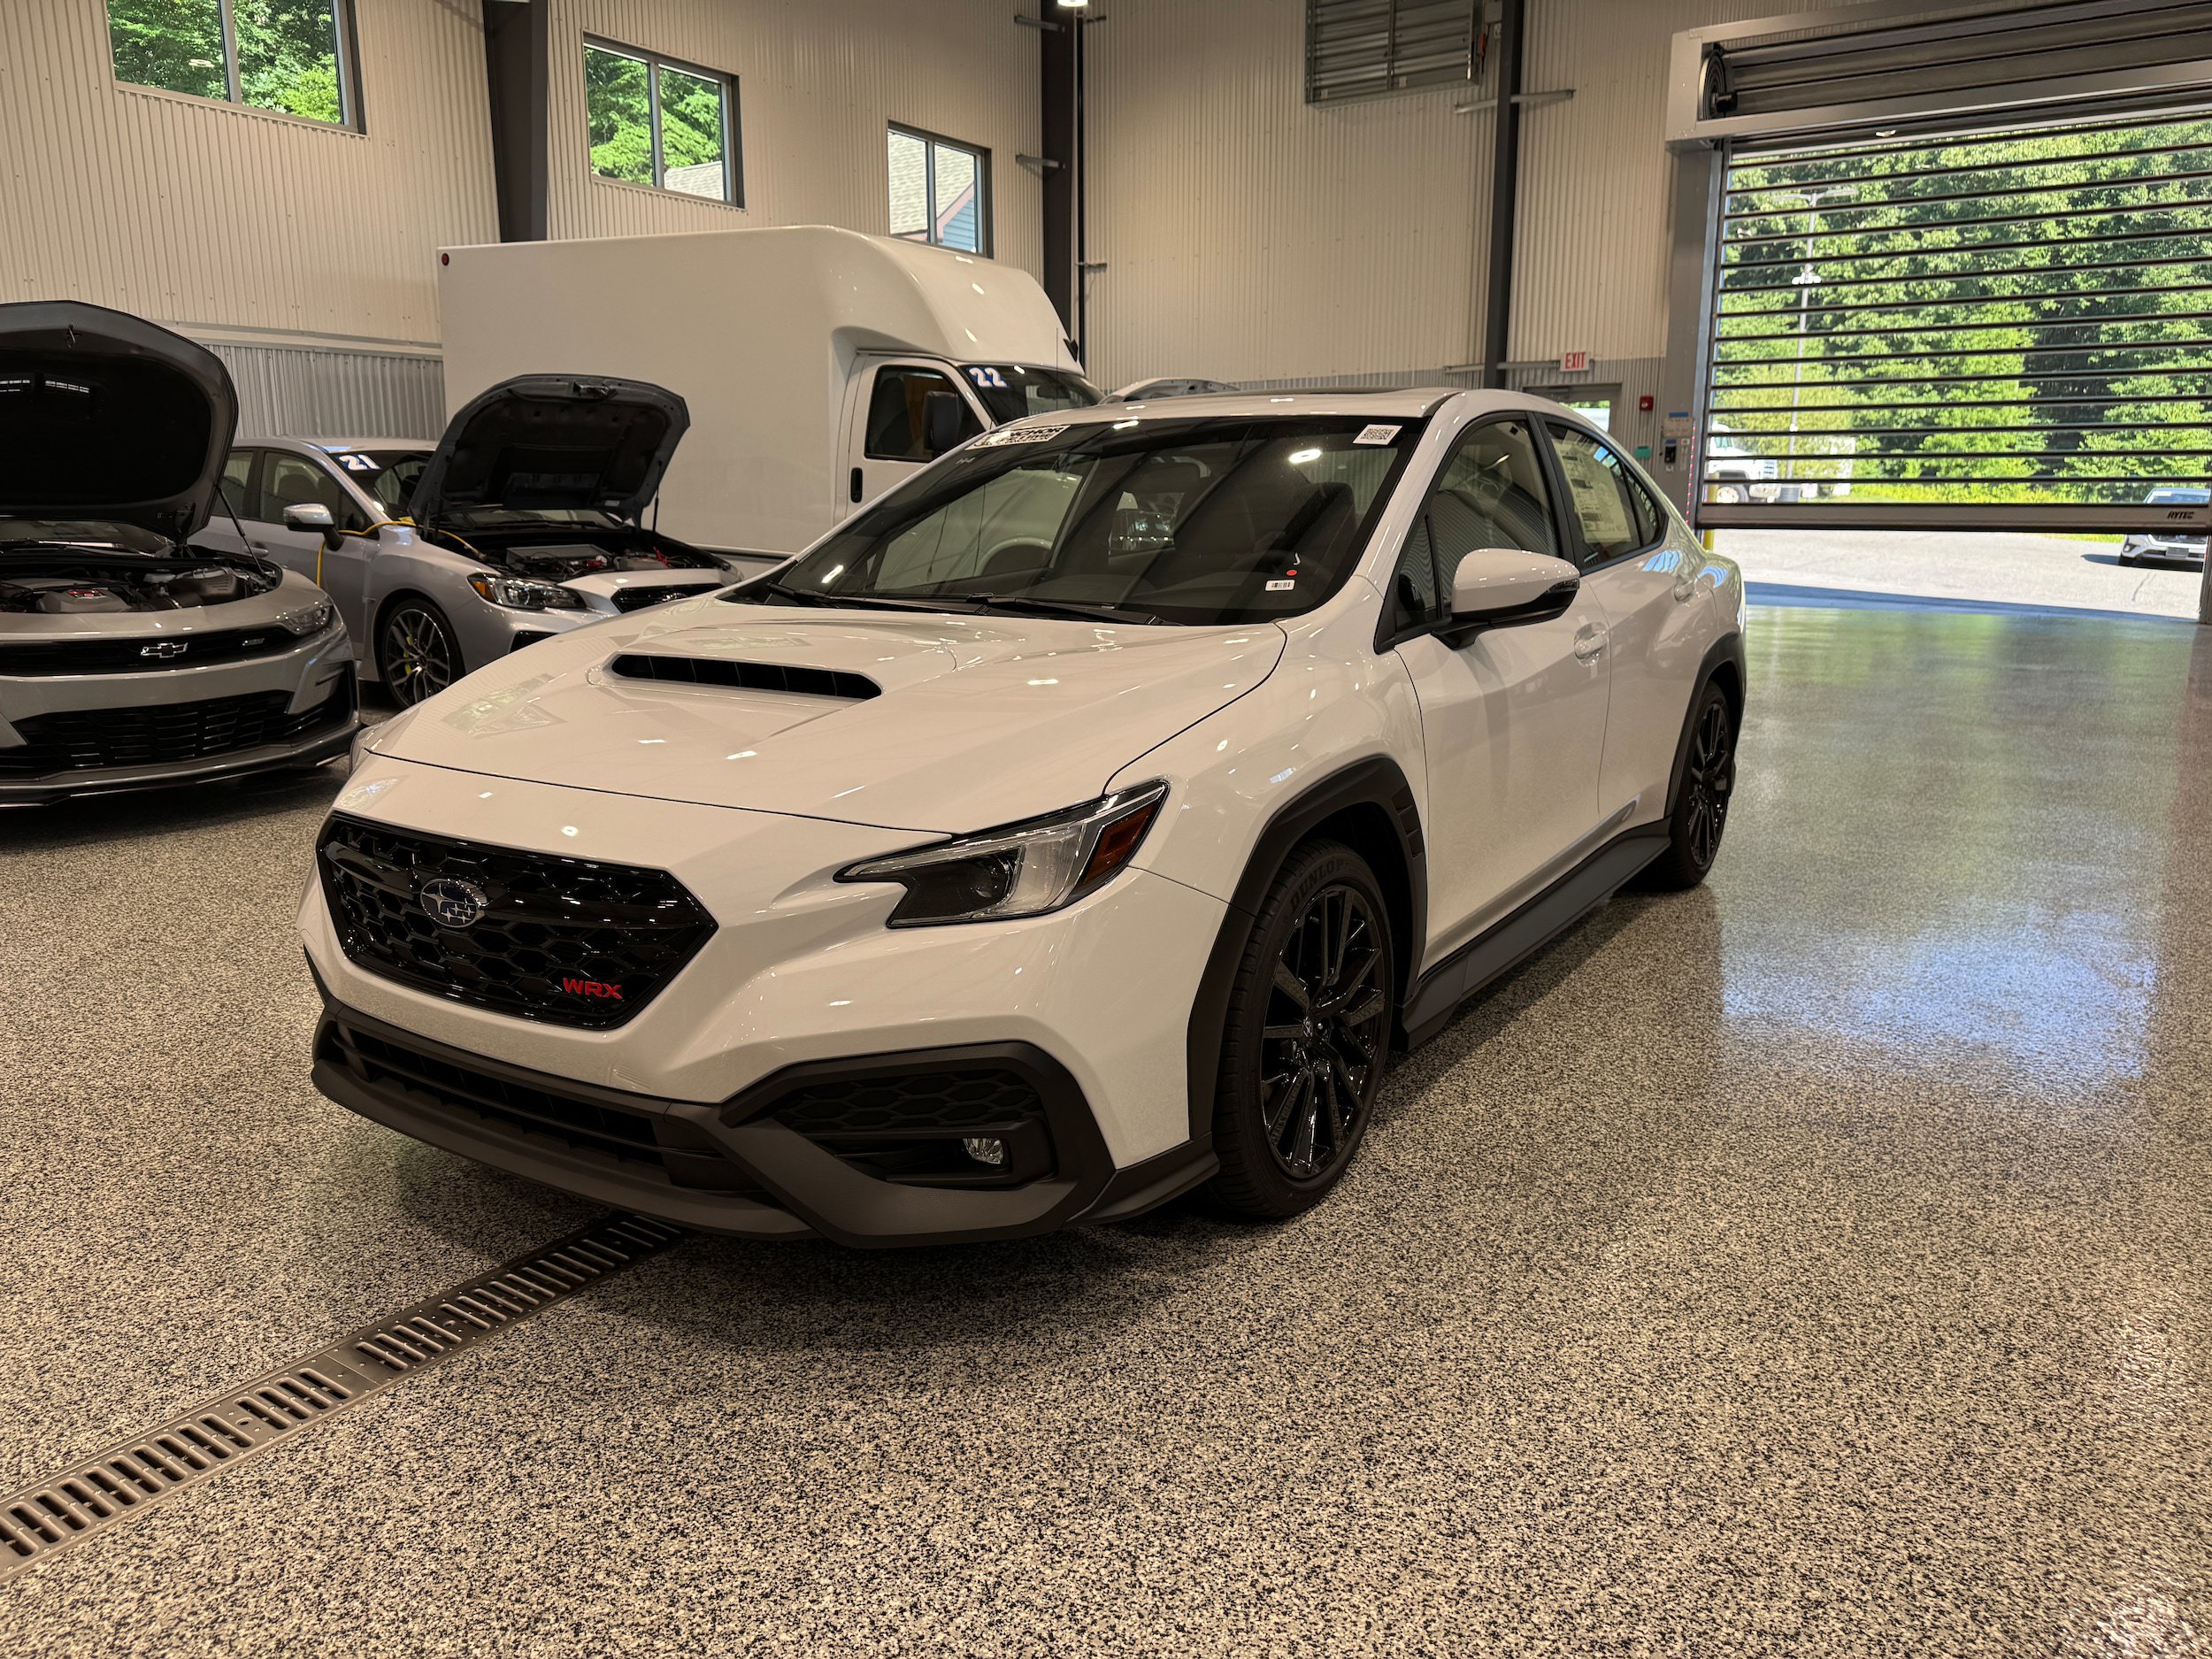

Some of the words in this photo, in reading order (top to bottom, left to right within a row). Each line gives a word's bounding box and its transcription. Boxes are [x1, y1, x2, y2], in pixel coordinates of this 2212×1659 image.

[1564, 351, 1586, 370] EXIT
[968, 367, 1008, 388] 22
[338, 454, 381, 471] 21
[2167, 511, 2195, 519] RYTEC
[1290, 858, 1345, 911] DUNLOP
[563, 977, 623, 1000] WRX
